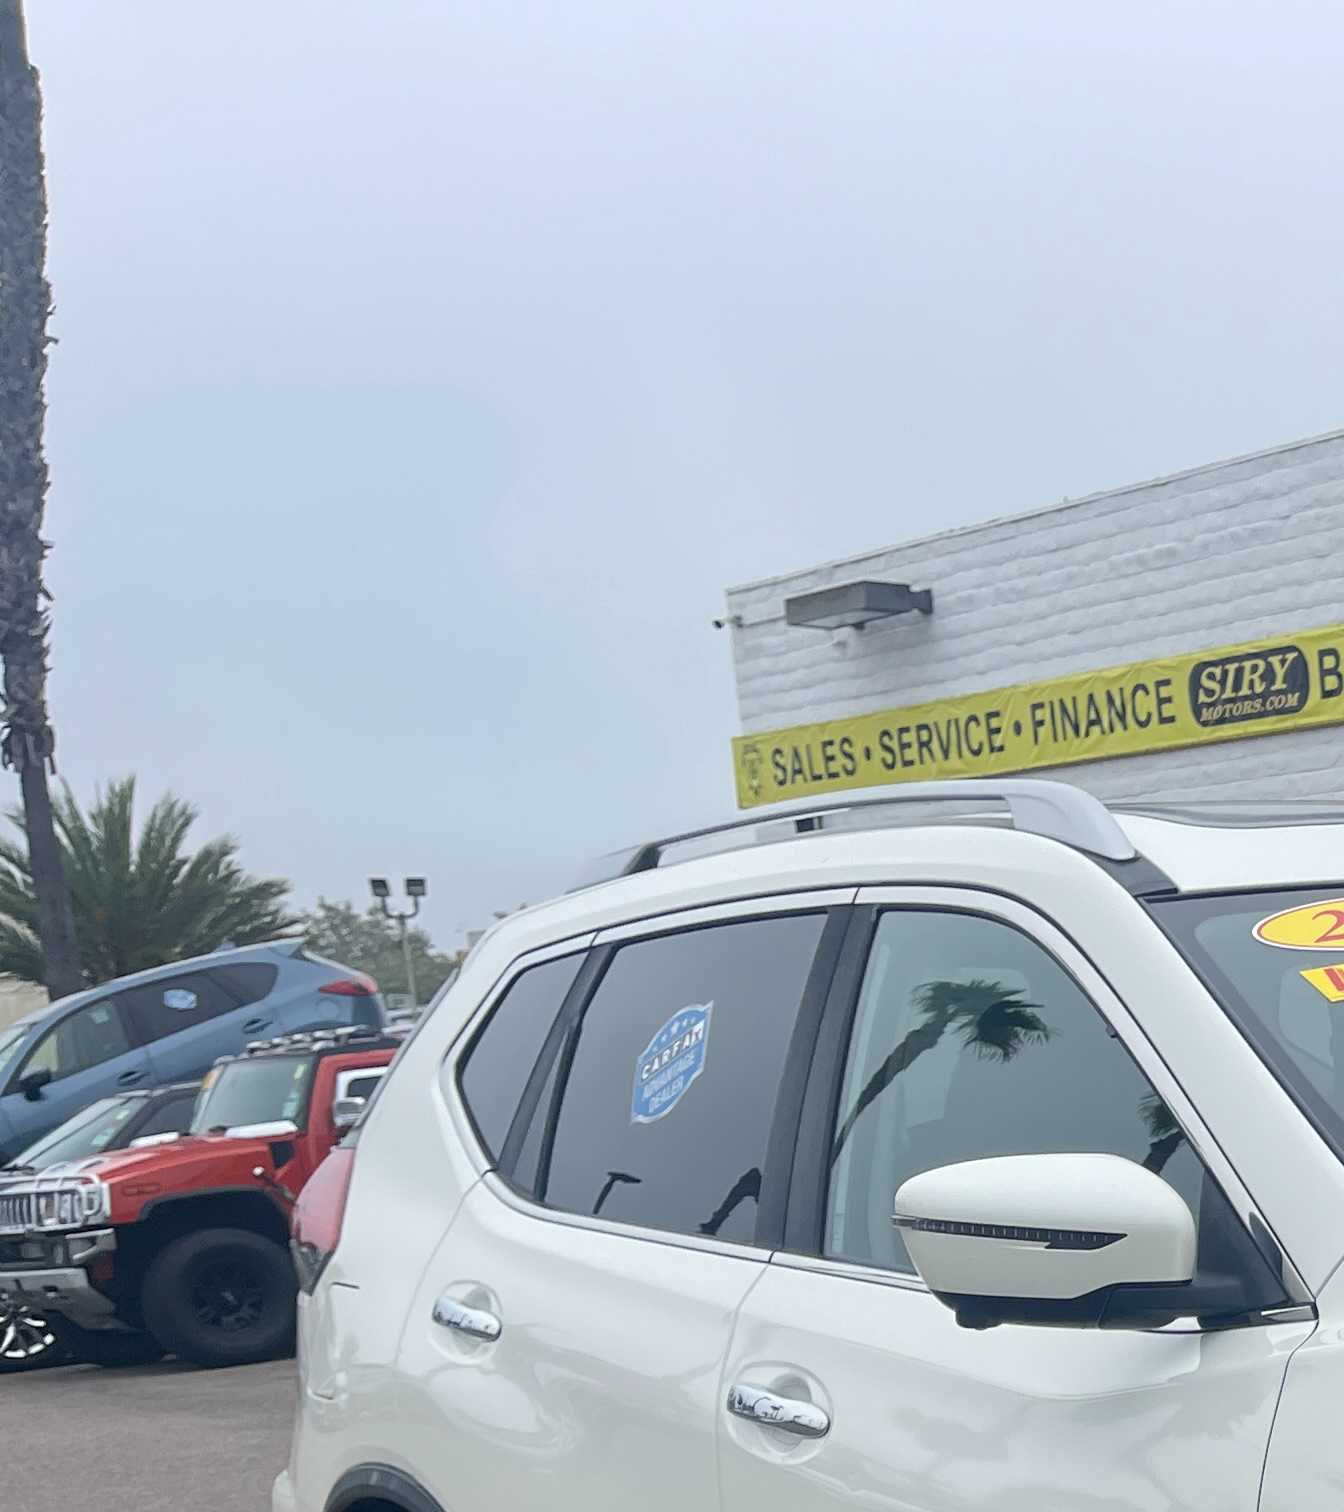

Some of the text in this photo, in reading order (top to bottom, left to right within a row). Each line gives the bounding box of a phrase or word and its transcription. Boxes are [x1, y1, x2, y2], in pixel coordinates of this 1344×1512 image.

[1197, 651, 1298, 704] SIRY
[770, 678, 1176, 786] SALES SERVICE FINANCE
[1200, 692, 1299, 721] MOTORS.COM
